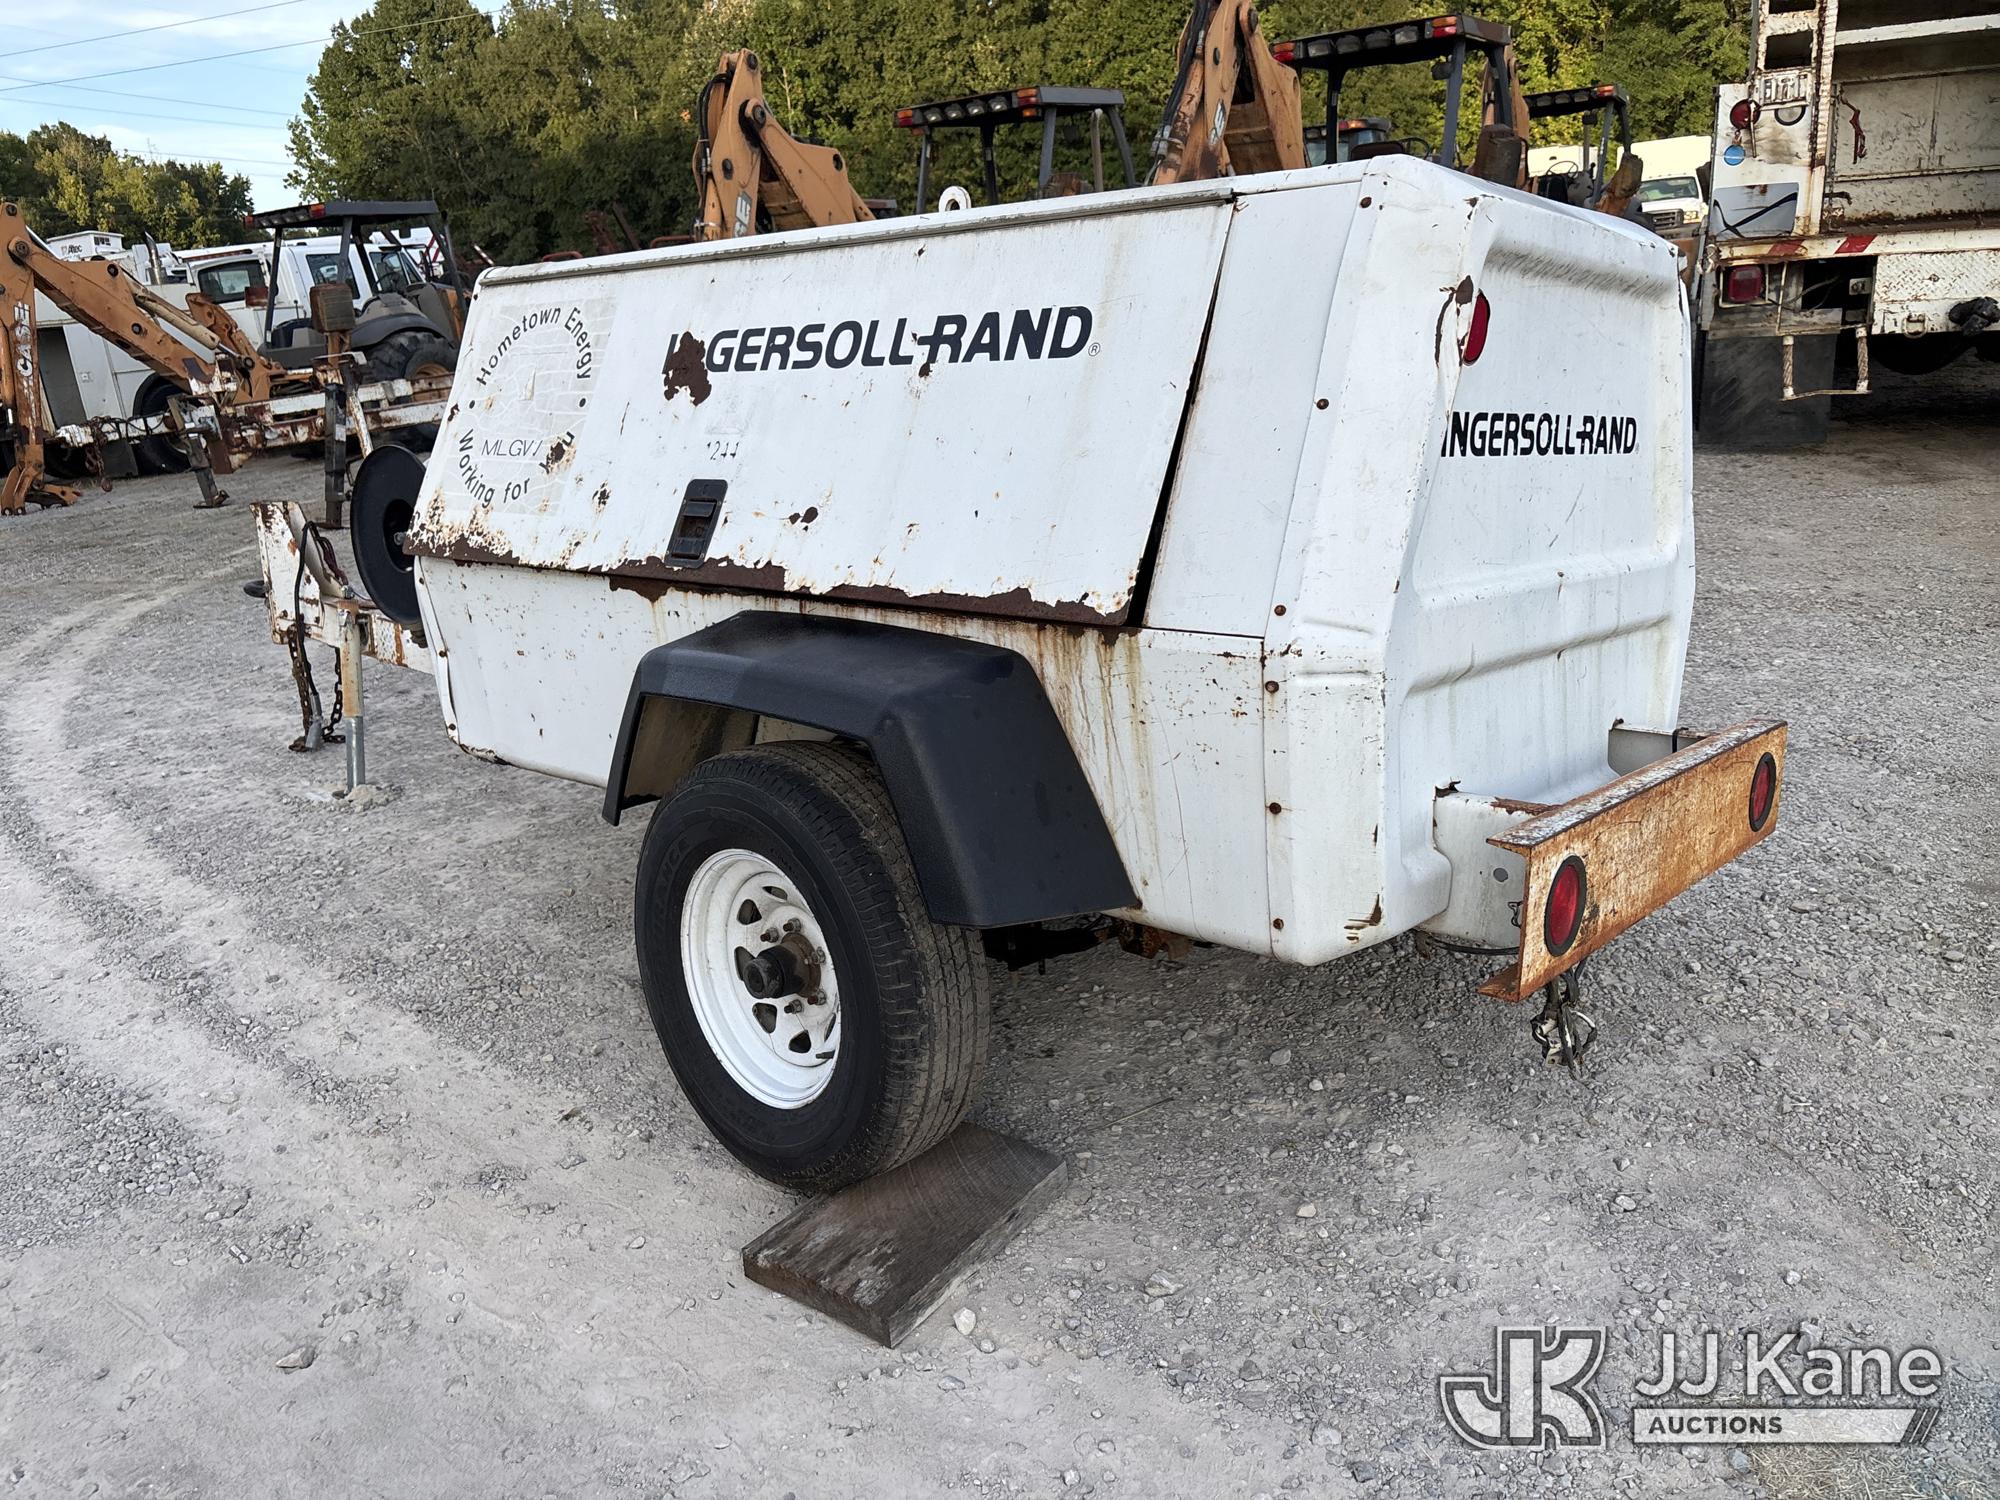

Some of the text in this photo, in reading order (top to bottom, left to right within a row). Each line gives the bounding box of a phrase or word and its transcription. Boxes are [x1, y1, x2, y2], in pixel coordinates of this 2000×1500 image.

[476, 306, 592, 386] Hometown Energy
[662, 306, 1093, 374] IGERSOLL-RAND
[459, 428, 575, 509] Working for yu
